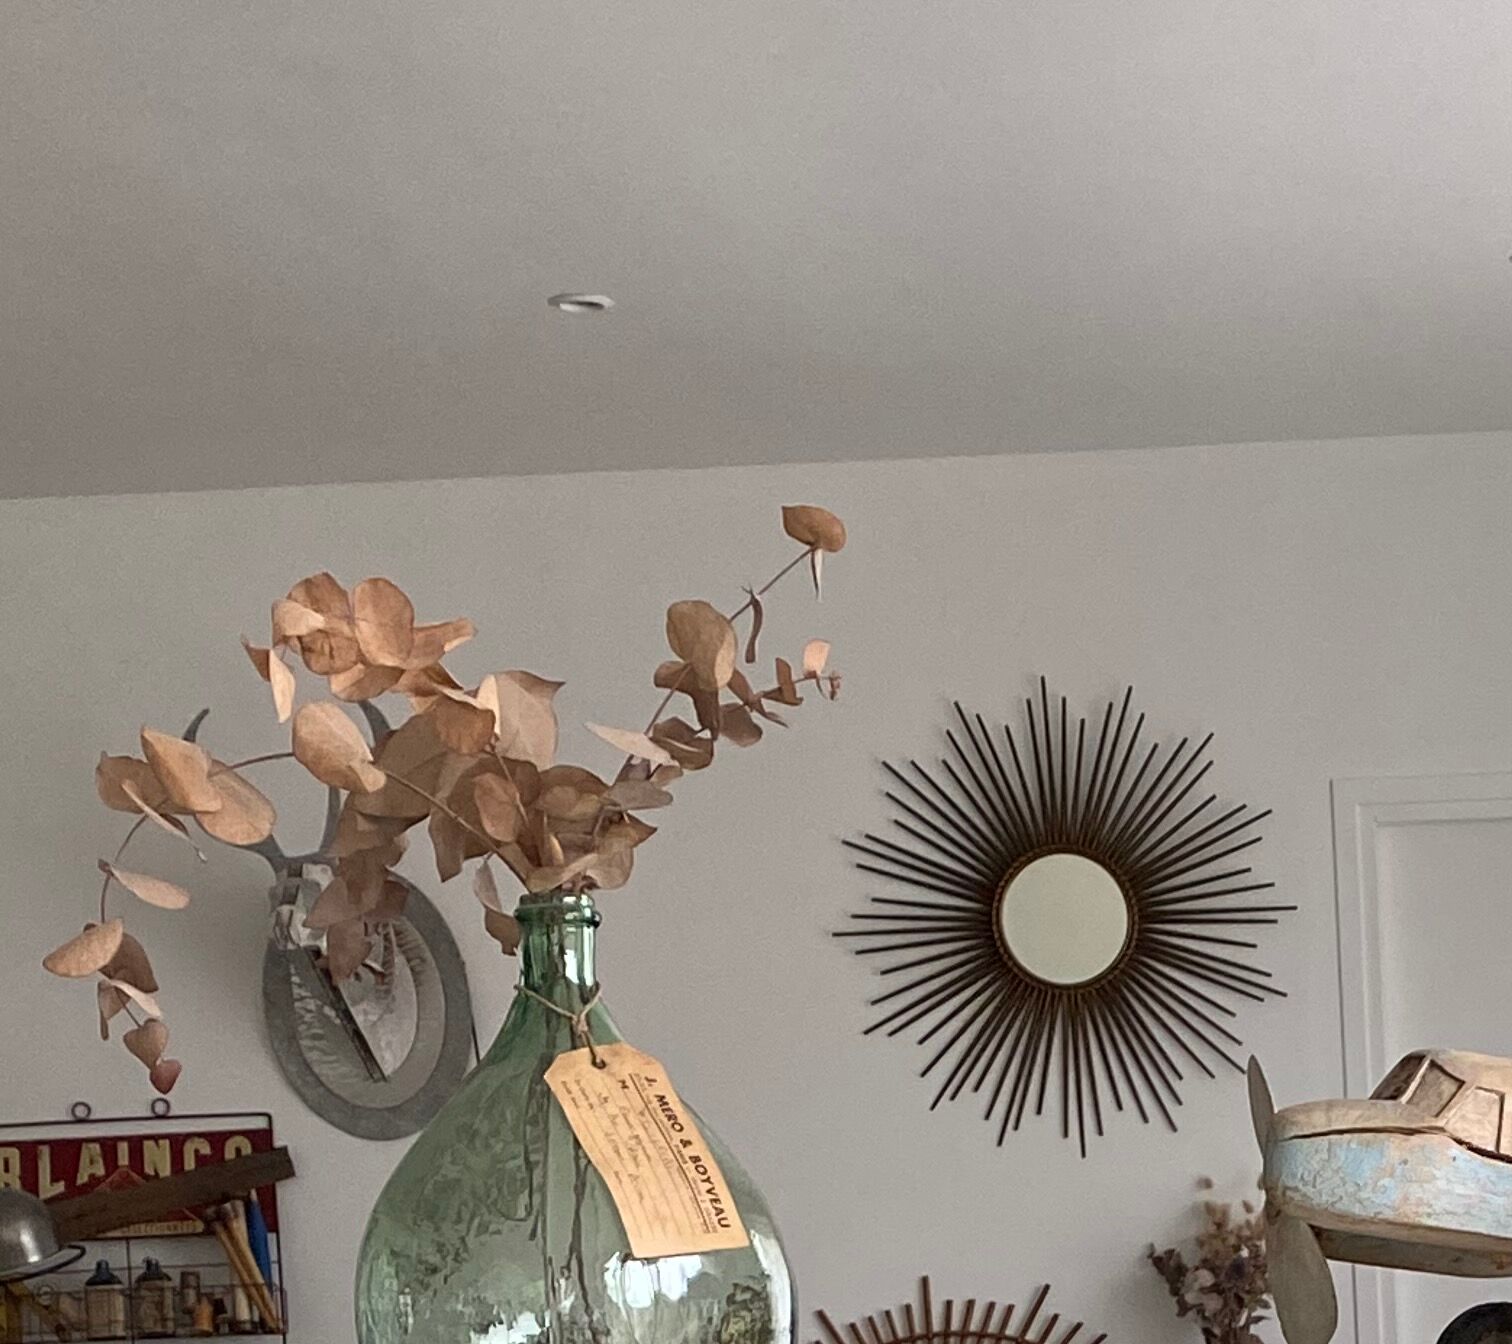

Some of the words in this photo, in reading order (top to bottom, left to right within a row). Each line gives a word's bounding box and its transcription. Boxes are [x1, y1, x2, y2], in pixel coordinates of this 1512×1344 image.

[644, 1075, 658, 1087] J.
[654, 1092, 685, 1133] MERO
[680, 1137, 693, 1149] &
[689, 1154, 731, 1229] BOYVEAU
